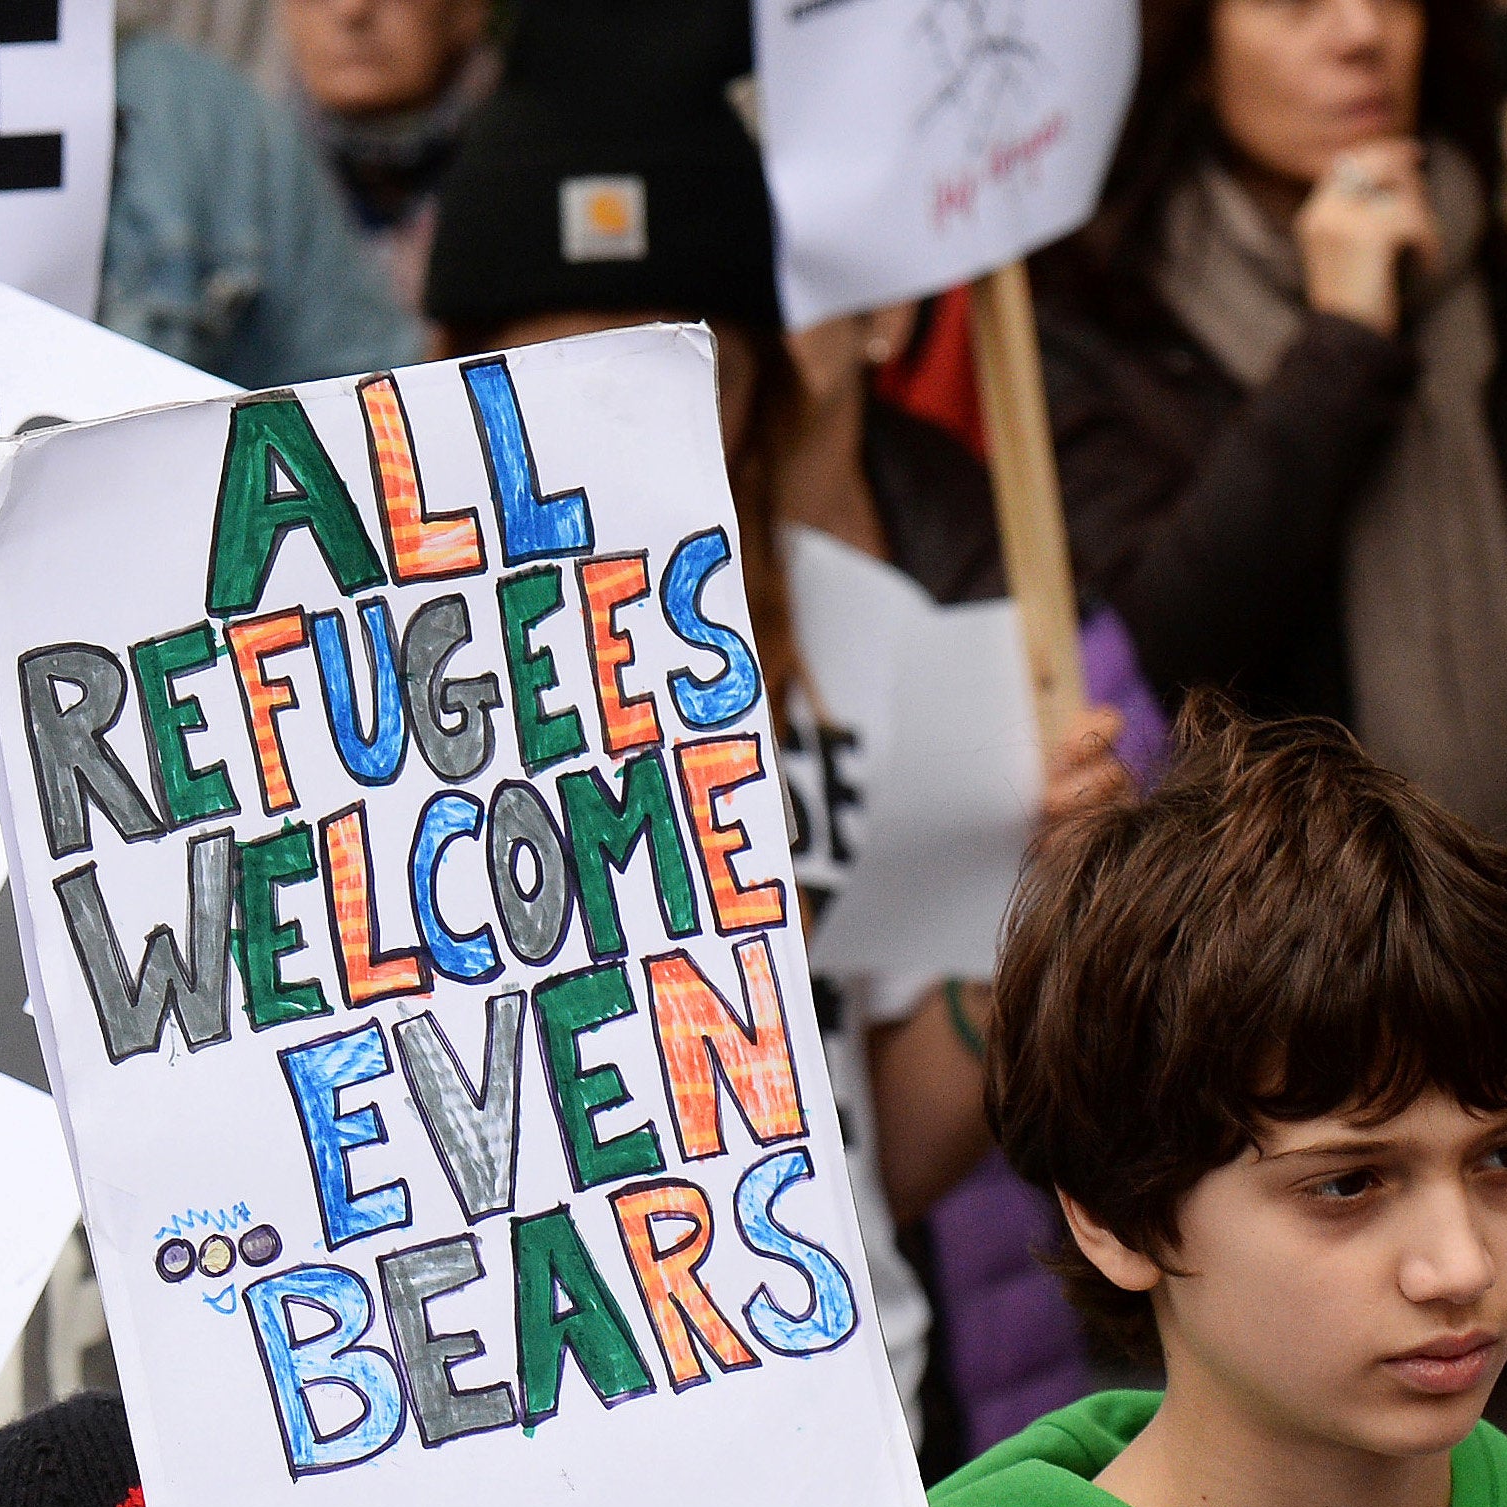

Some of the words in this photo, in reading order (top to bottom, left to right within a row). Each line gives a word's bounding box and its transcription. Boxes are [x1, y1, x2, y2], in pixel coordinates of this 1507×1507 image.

[206, 354, 594, 617] ALL
[19, 526, 762, 859] REFUGEES
[52, 734, 788, 1065] WELCOME
[281, 934, 811, 1250] EVEN
[242, 1147, 857, 1483] BEARS
